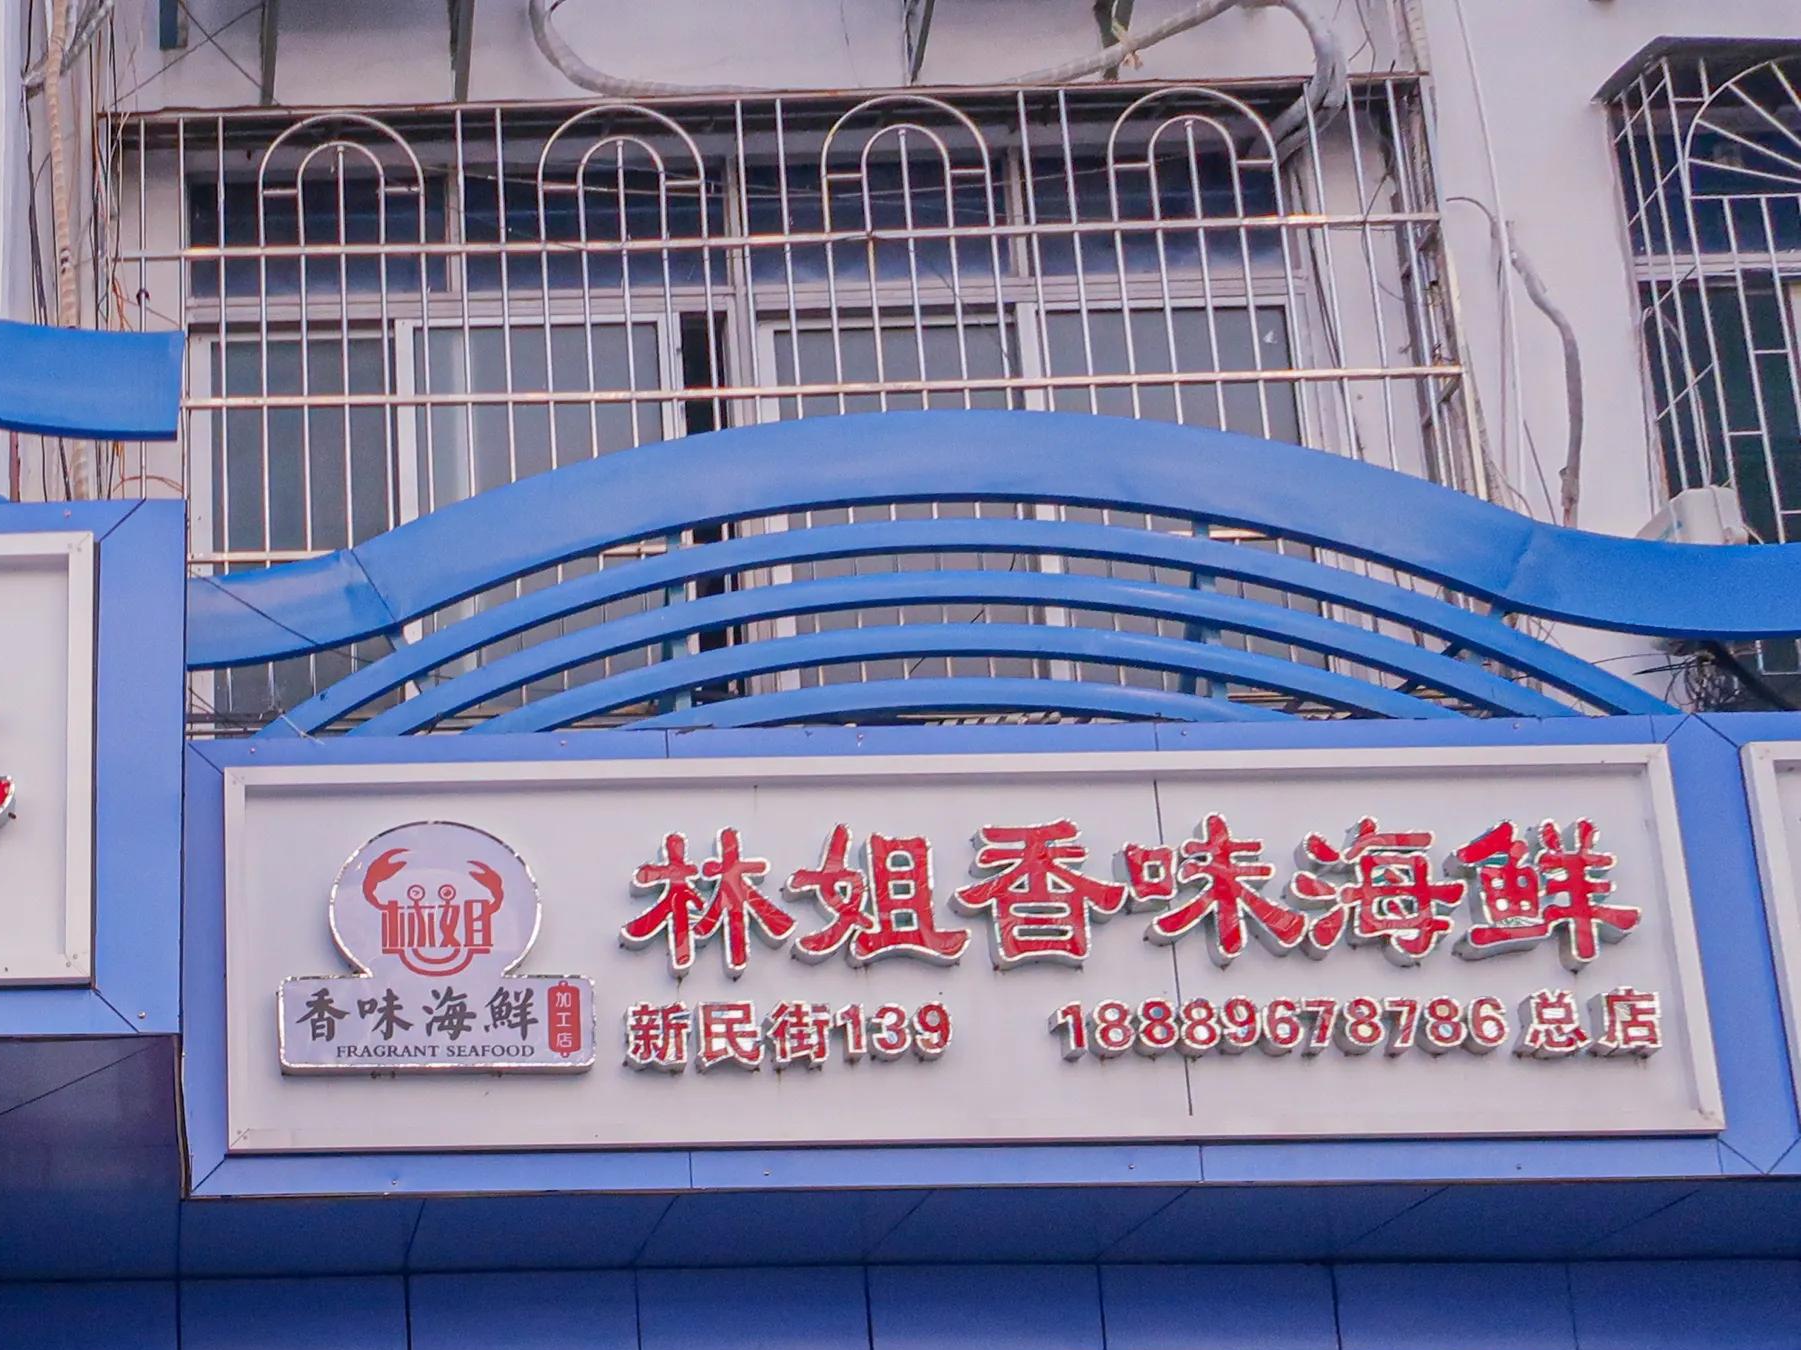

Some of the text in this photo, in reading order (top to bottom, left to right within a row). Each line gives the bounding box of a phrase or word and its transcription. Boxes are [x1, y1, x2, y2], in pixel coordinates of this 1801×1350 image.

[381, 899, 494, 953] 林姐
[554, 991, 574, 1049] 加工店
[624, 1001, 953, 1072] 新民街139
[1051, 986, 1663, 1061] 18889678786 总店
[336, 1043, 536, 1059] FRAGRANT SEAFOOD
